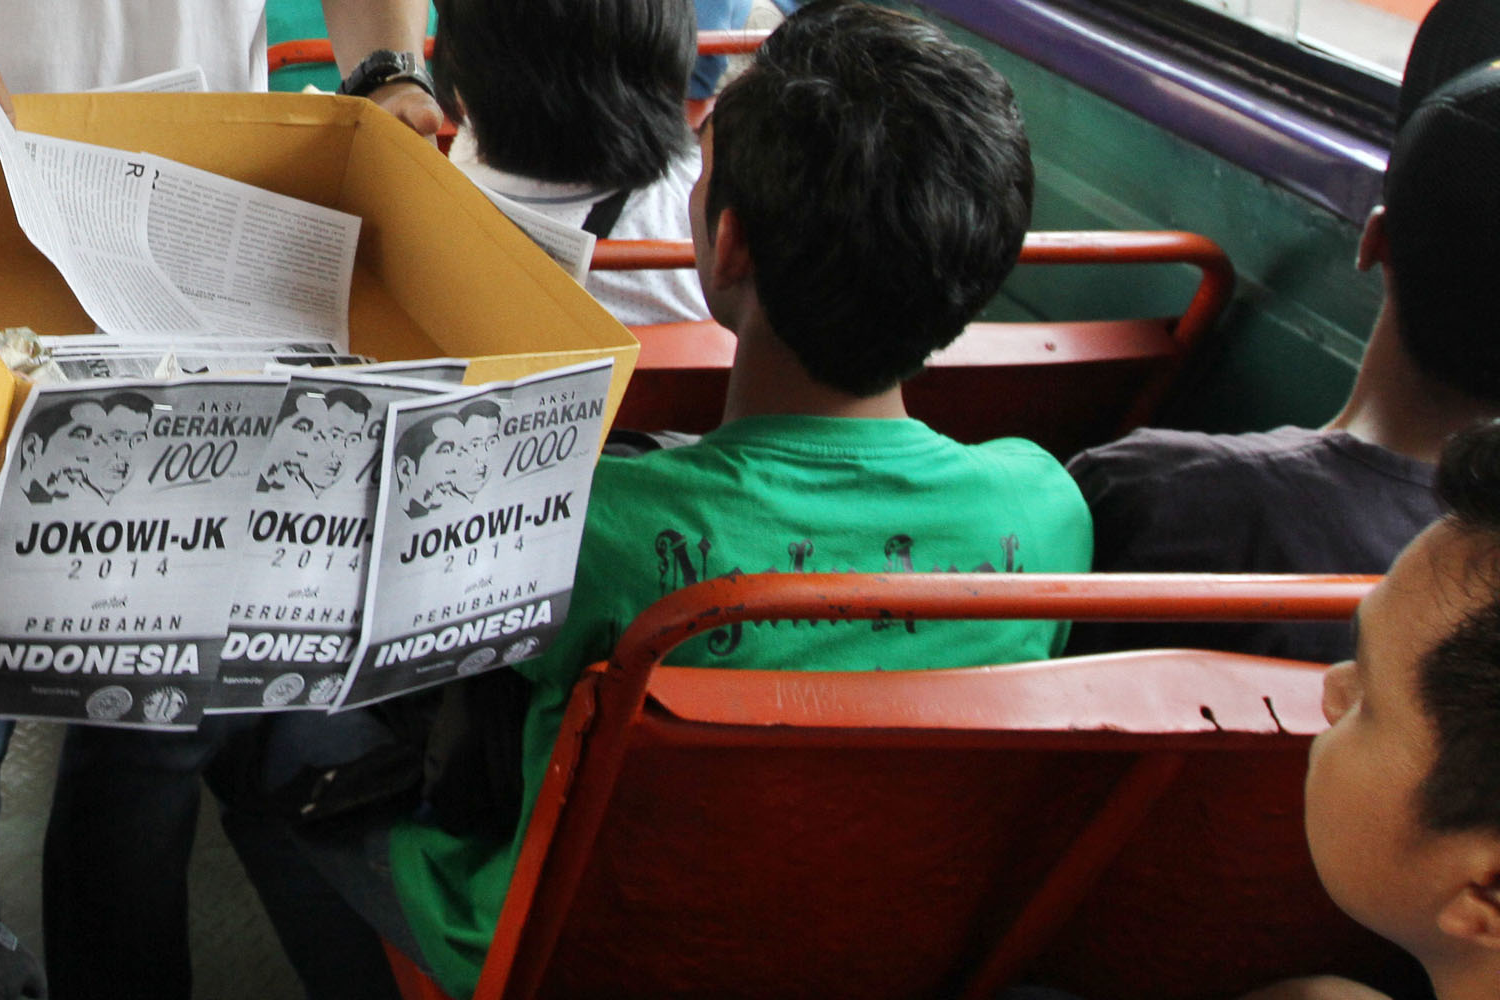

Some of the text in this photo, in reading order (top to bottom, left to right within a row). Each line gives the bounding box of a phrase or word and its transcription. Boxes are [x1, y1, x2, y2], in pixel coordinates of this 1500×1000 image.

[153, 415, 274, 437] GERAKAN
[503, 398, 603, 437] GERAKAN
[148, 440, 238, 484] 1000
[503, 425, 578, 477] 1000
[15, 517, 229, 555] JOKOWI-JK
[400, 491, 574, 564] JOKOWI-JK
[67, 559, 170, 580] 2014
[271, 549, 360, 571] 2014
[443, 534, 525, 574] 2014
[413, 580, 538, 627] PERUBAHAN
[25, 616, 184, 632] PERUBAHAN
[374, 600, 552, 669] INDONESIA
